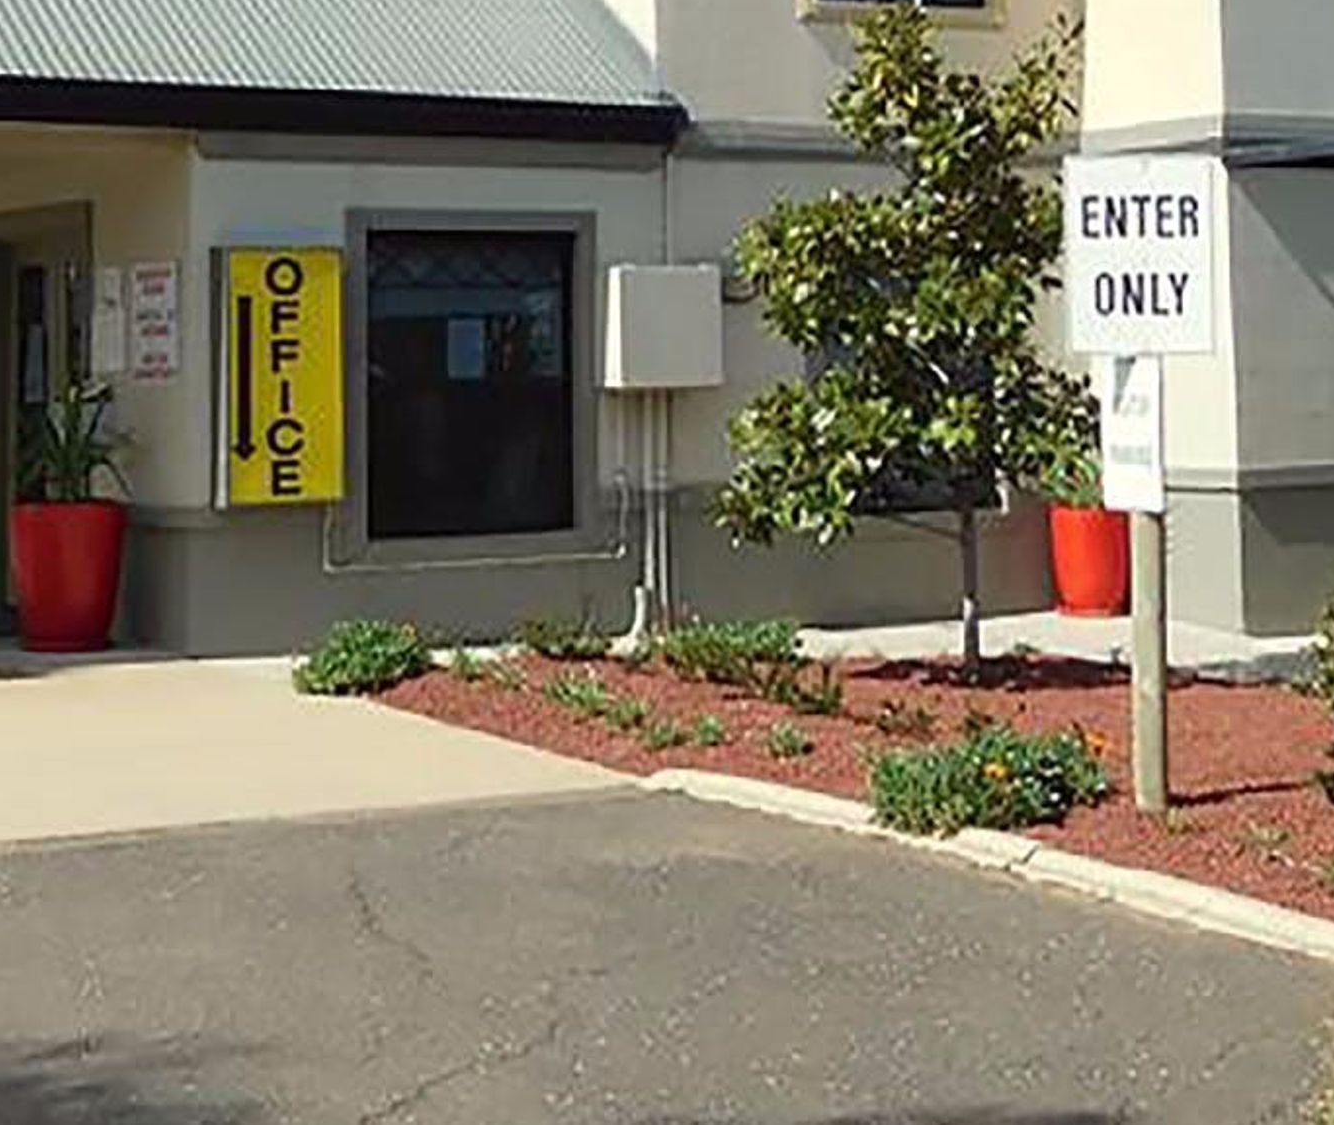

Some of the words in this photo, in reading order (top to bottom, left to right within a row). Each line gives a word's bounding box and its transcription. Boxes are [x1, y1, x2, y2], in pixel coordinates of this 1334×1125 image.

[1082, 195, 1199, 238] ENTER
[1095, 272, 1189, 315] ONLY
[265, 257, 304, 496] OFFICE
